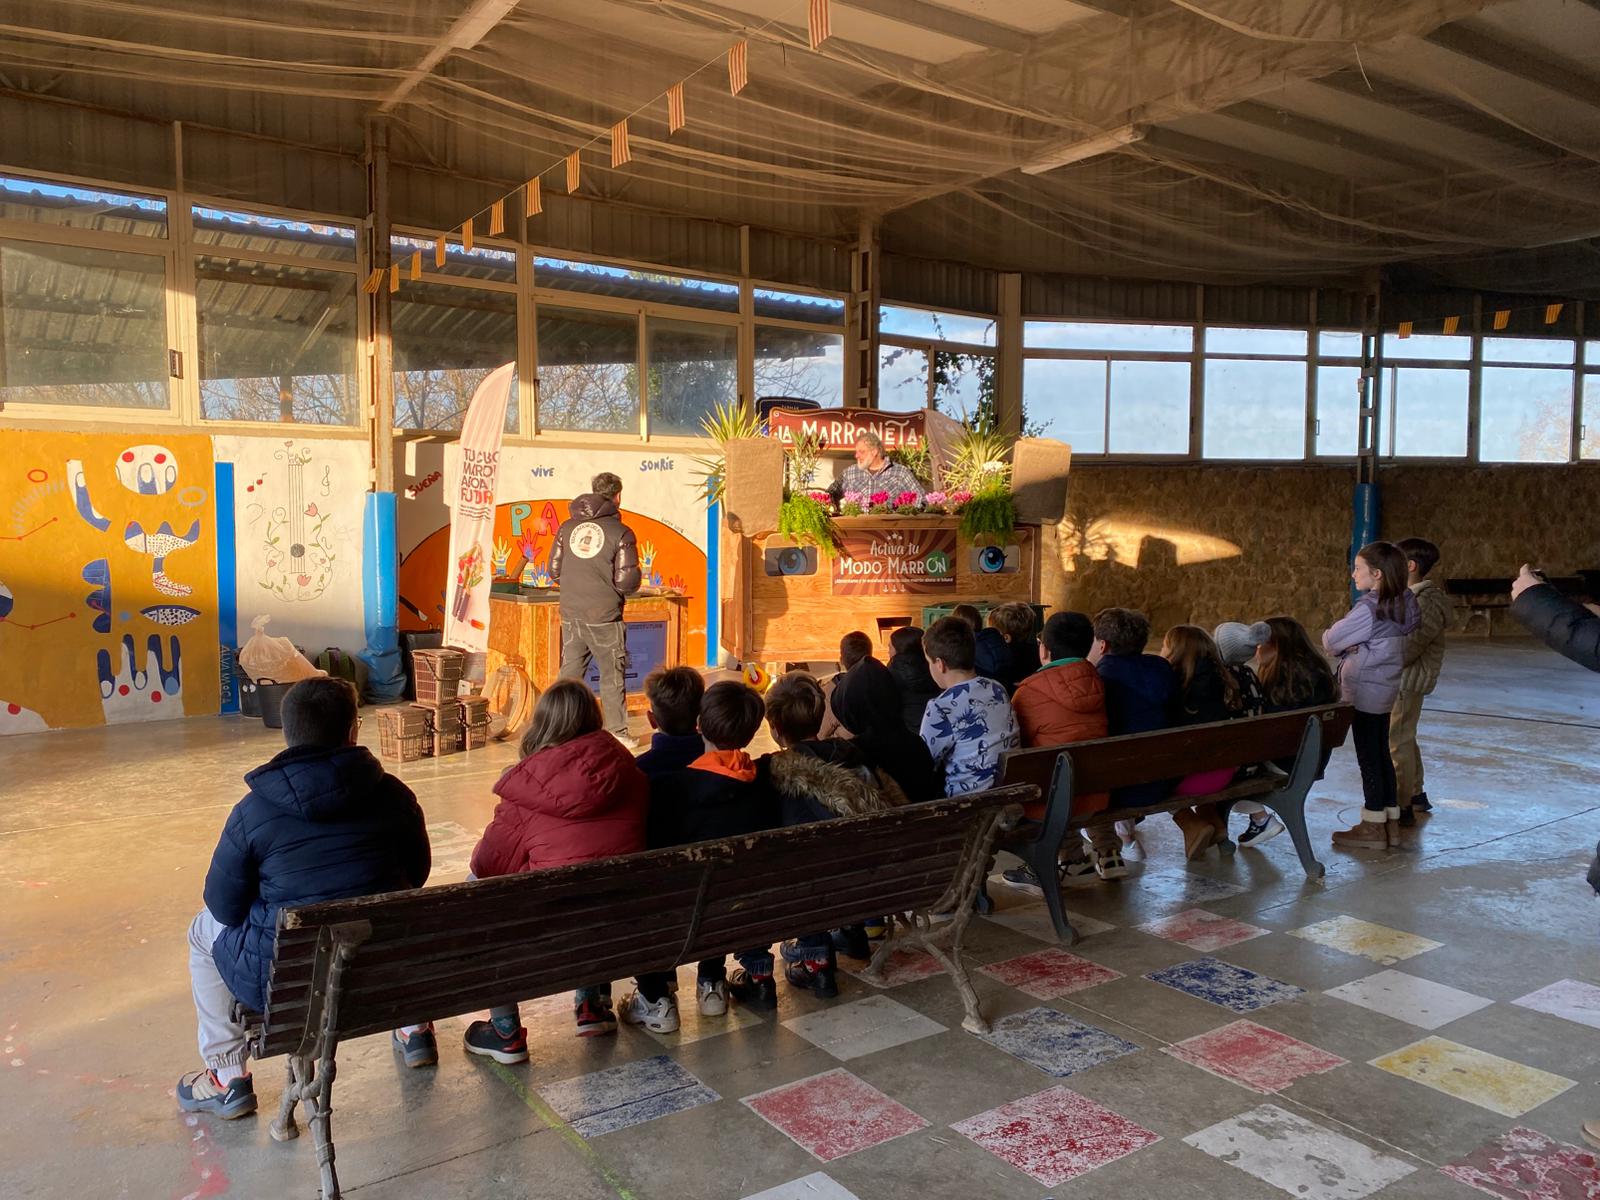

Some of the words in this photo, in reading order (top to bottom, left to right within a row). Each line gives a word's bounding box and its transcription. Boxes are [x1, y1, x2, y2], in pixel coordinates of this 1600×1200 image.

[778, 425, 793, 443] LA
[463, 447, 475, 462] TU
[870, 540, 904, 556] Activa
[908, 542, 920, 555] tu
